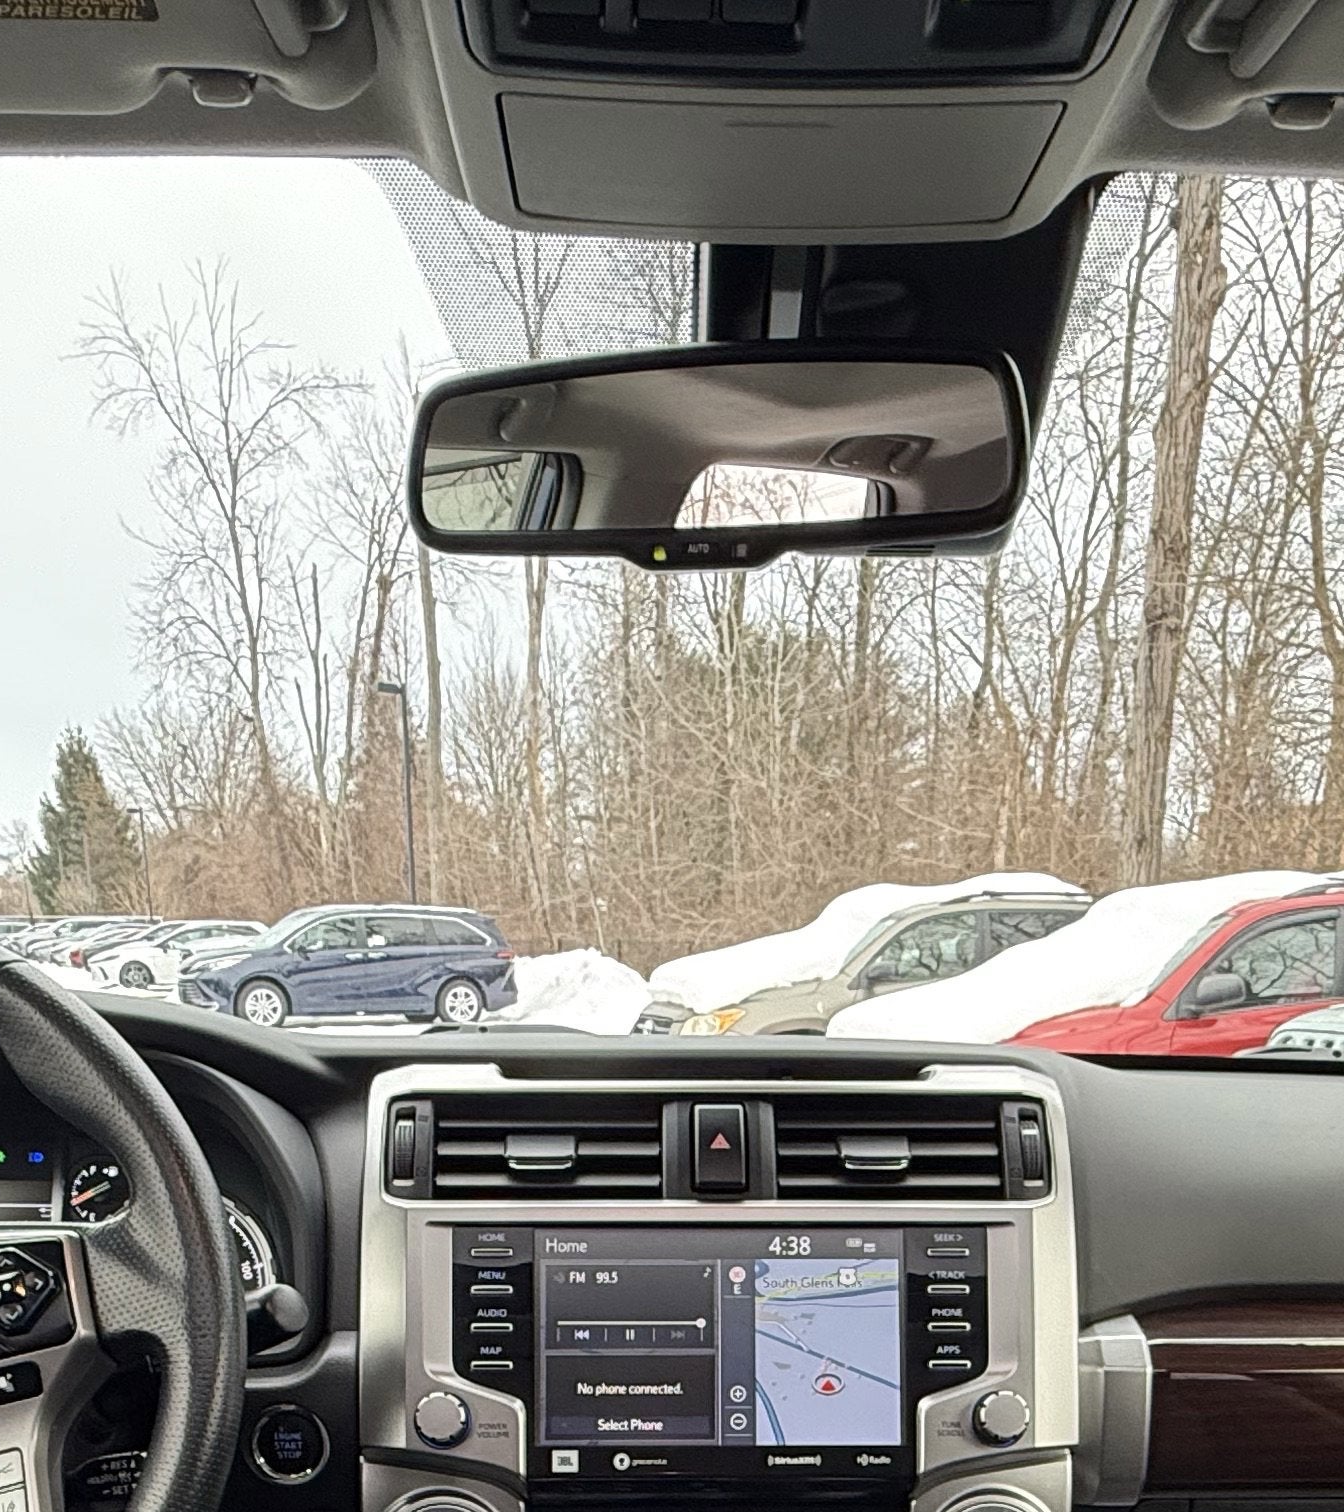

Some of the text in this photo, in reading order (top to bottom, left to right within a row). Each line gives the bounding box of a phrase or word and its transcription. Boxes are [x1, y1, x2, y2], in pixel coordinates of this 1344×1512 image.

[687, 543, 710, 554] AUTO
[477, 1233, 507, 1243] HOME
[545, 1237, 589, 1254] Home
[768, 1235, 812, 1257] 4:38
[240, 1260, 254, 1281] 100
[477, 1270, 507, 1280] MENU
[569, 1271, 619, 1284] FM 99.5
[762, 1276, 798, 1290] South
[800, 1276, 834, 1290] Glens
[476, 1308, 508, 1318] AUDIO
[931, 1307, 963, 1318] PHONE
[479, 1346, 503, 1356] MAP
[936, 1345, 961, 1355] APPS
[576, 1382, 684, 1397] No phone connected.
[477, 1422, 508, 1431] POWER
[597, 1418, 664, 1432] Select Phone
[476, 1430, 510, 1439] VOLUME
[273, 1441, 303, 1450] START
[277, 1449, 303, 1460] STOP
[556, 1455, 574, 1467] JBL
